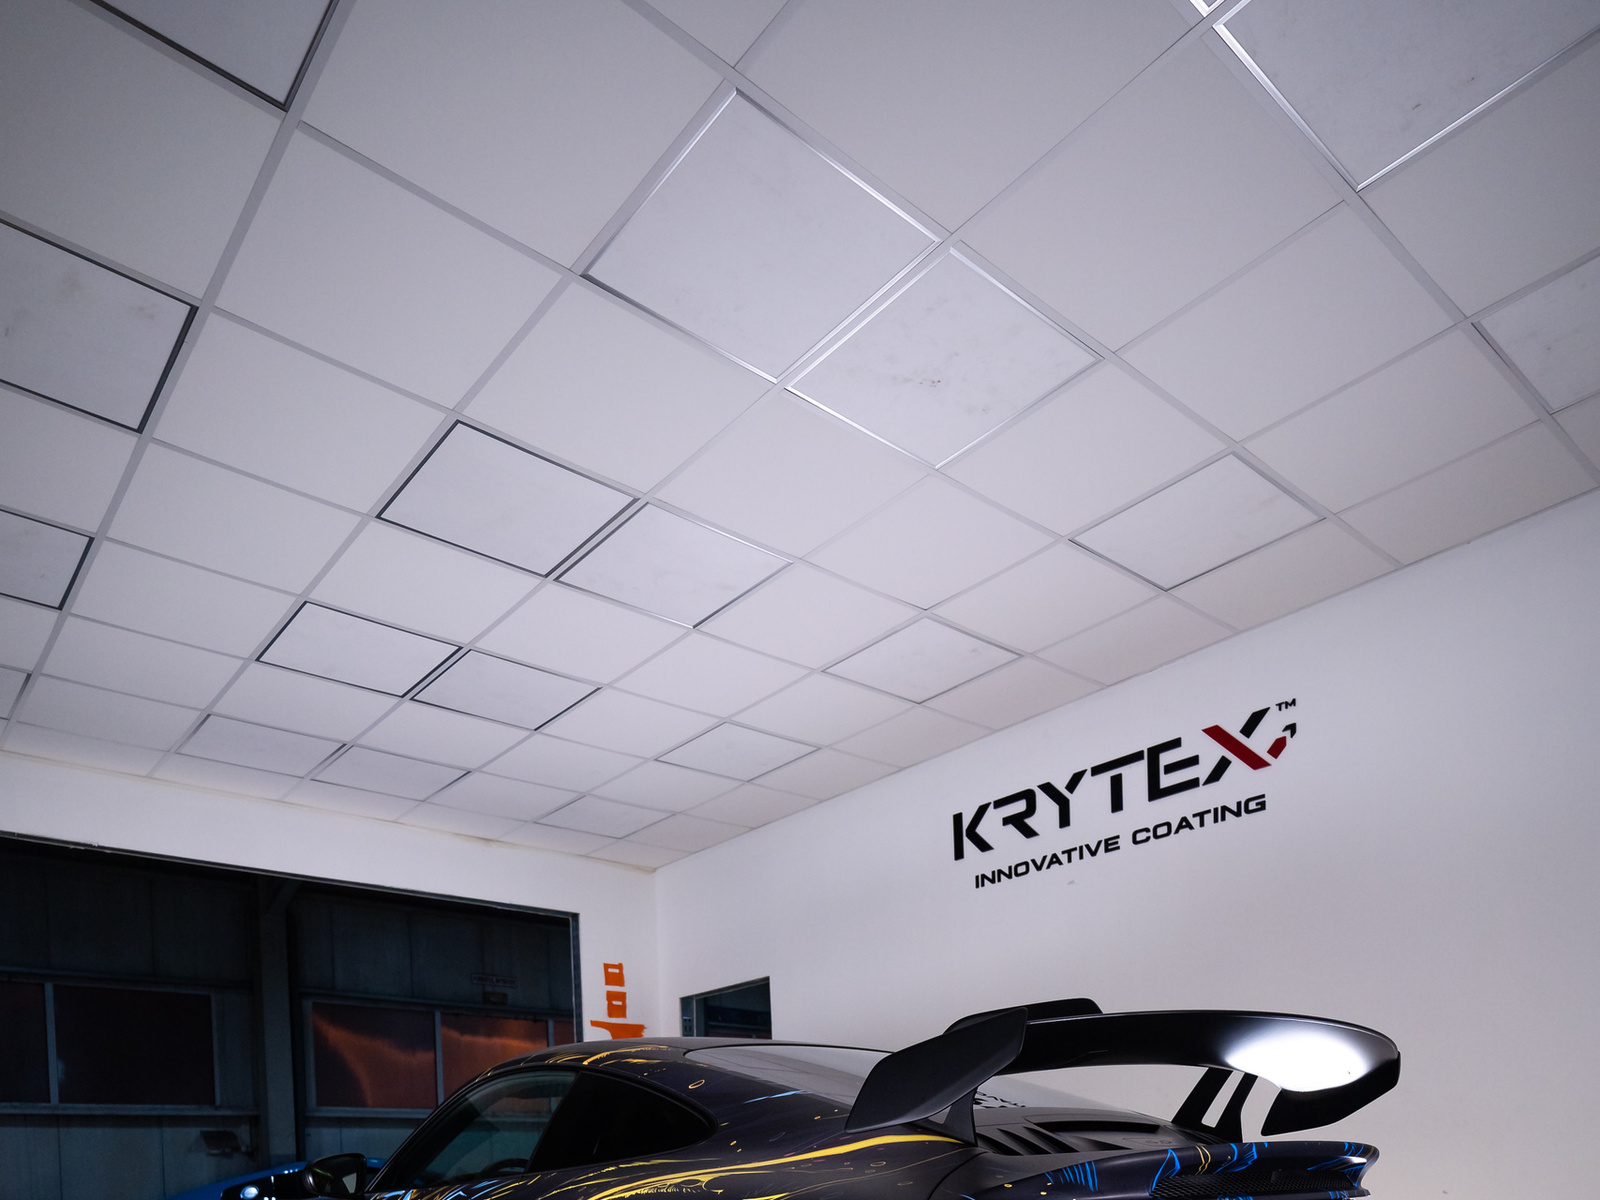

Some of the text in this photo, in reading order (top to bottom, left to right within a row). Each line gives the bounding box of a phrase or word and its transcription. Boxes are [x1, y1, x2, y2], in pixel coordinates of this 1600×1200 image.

[952, 706, 1273, 862] KRYTEX
[974, 793, 1267, 889] INNOVATIVE COATING
